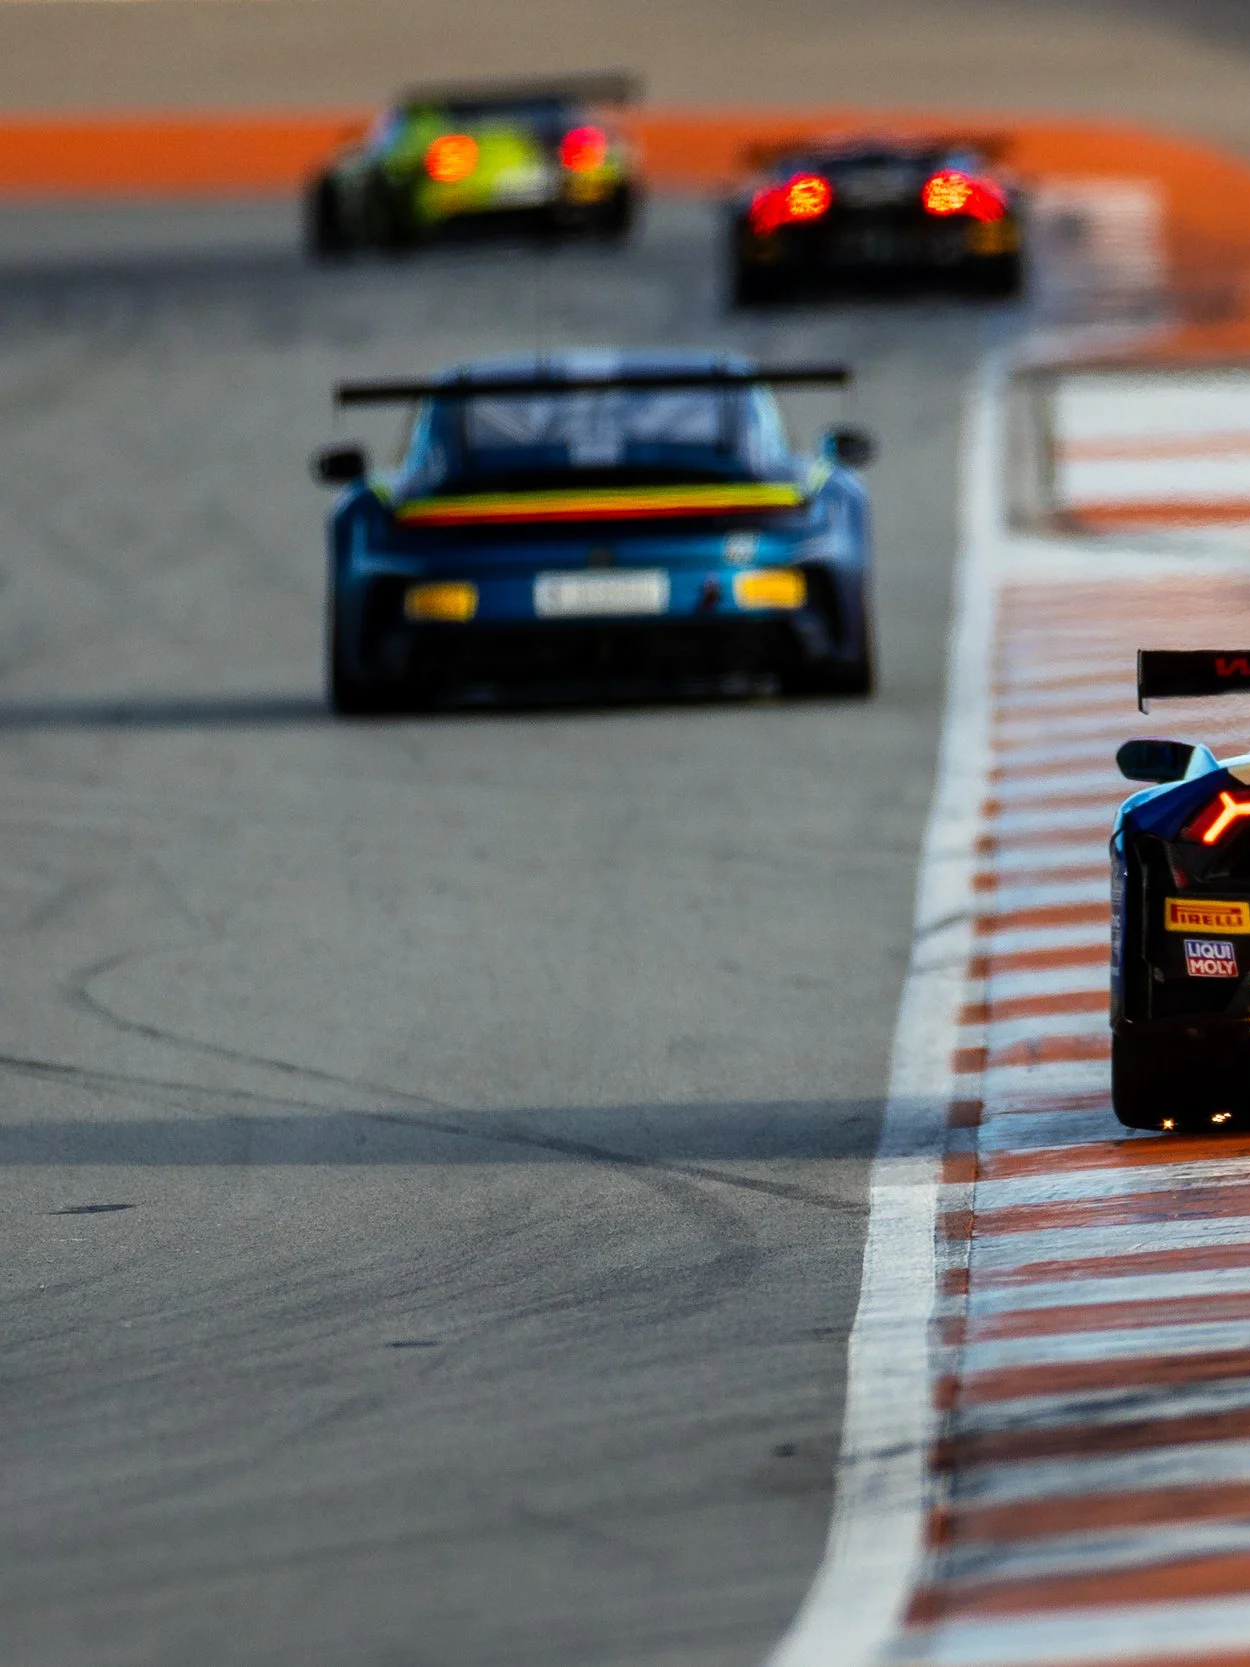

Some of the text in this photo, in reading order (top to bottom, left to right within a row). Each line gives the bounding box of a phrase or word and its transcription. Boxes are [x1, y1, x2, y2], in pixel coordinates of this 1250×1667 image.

[1170, 904, 1243, 927] PIRELLI
[1187, 942, 1233, 959] LIQUI
[1190, 959, 1235, 974] MOLY
